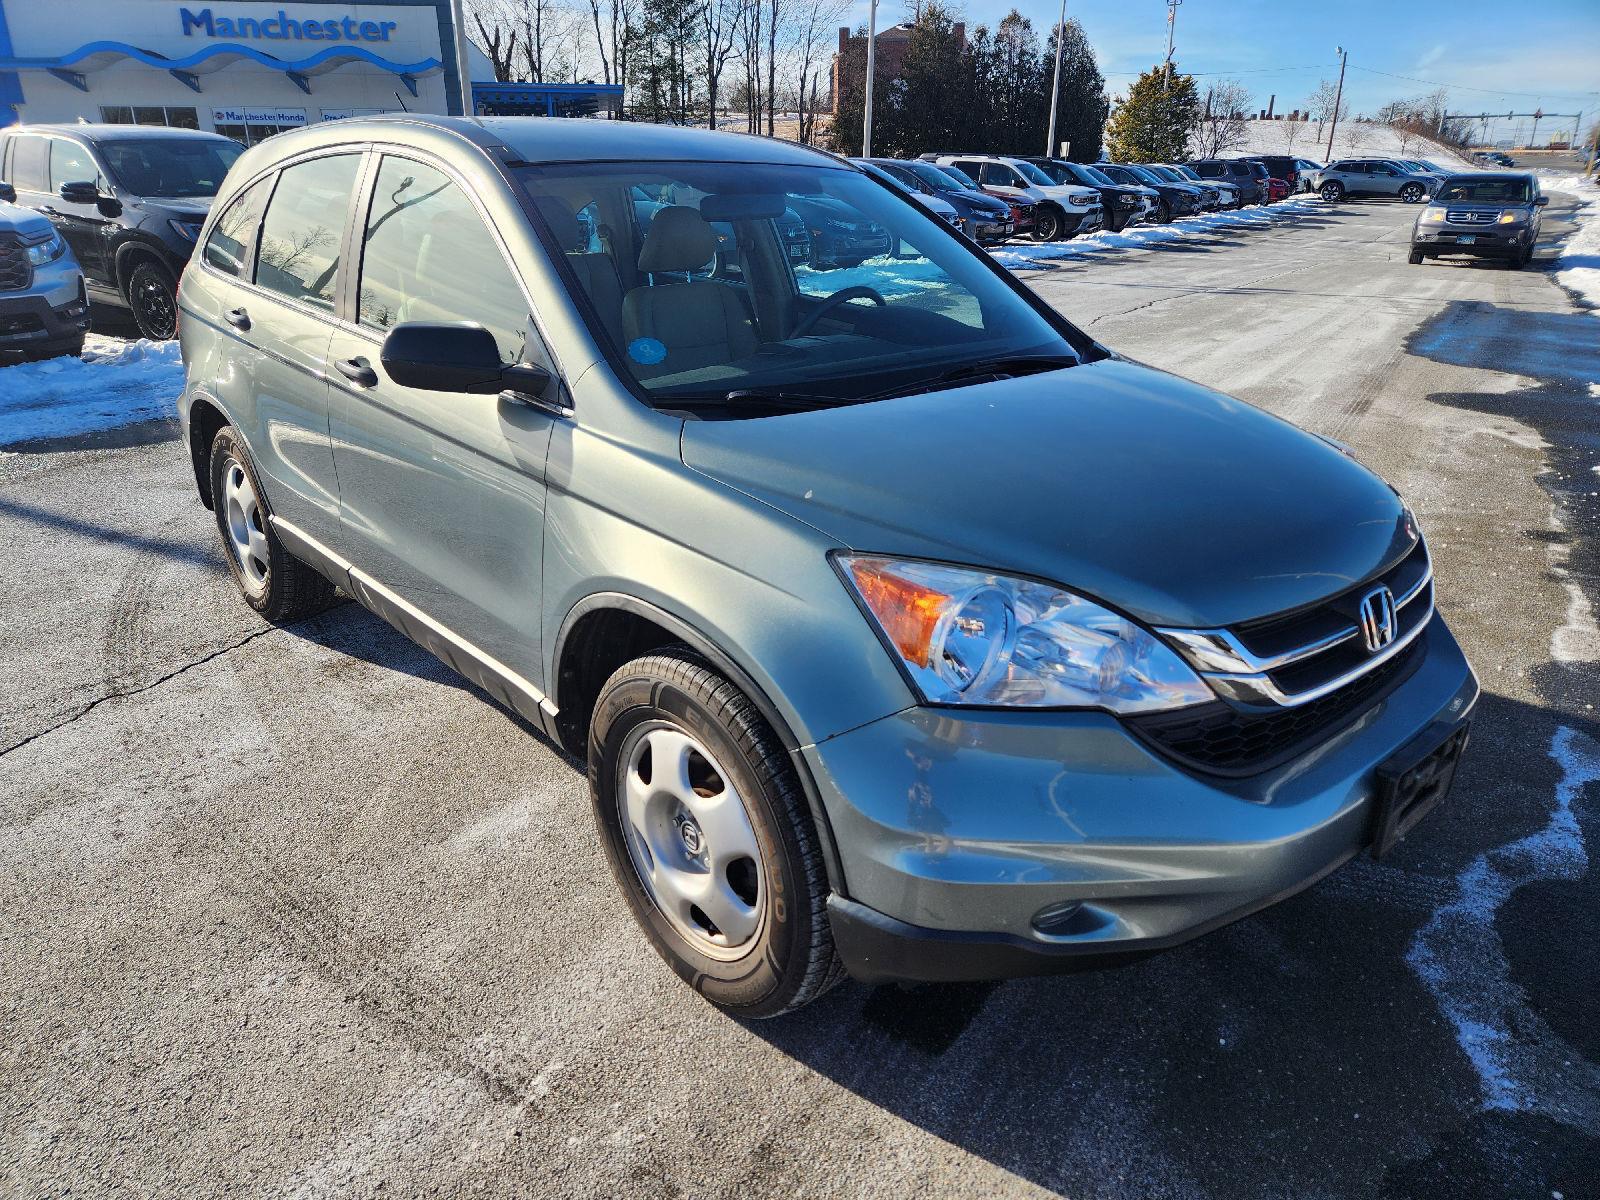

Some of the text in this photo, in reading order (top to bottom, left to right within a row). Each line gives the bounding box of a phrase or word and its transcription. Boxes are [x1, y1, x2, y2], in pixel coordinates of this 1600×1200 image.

[180, 8, 396, 41] Manchester
[226, 112, 305, 121] Manchester Honda
